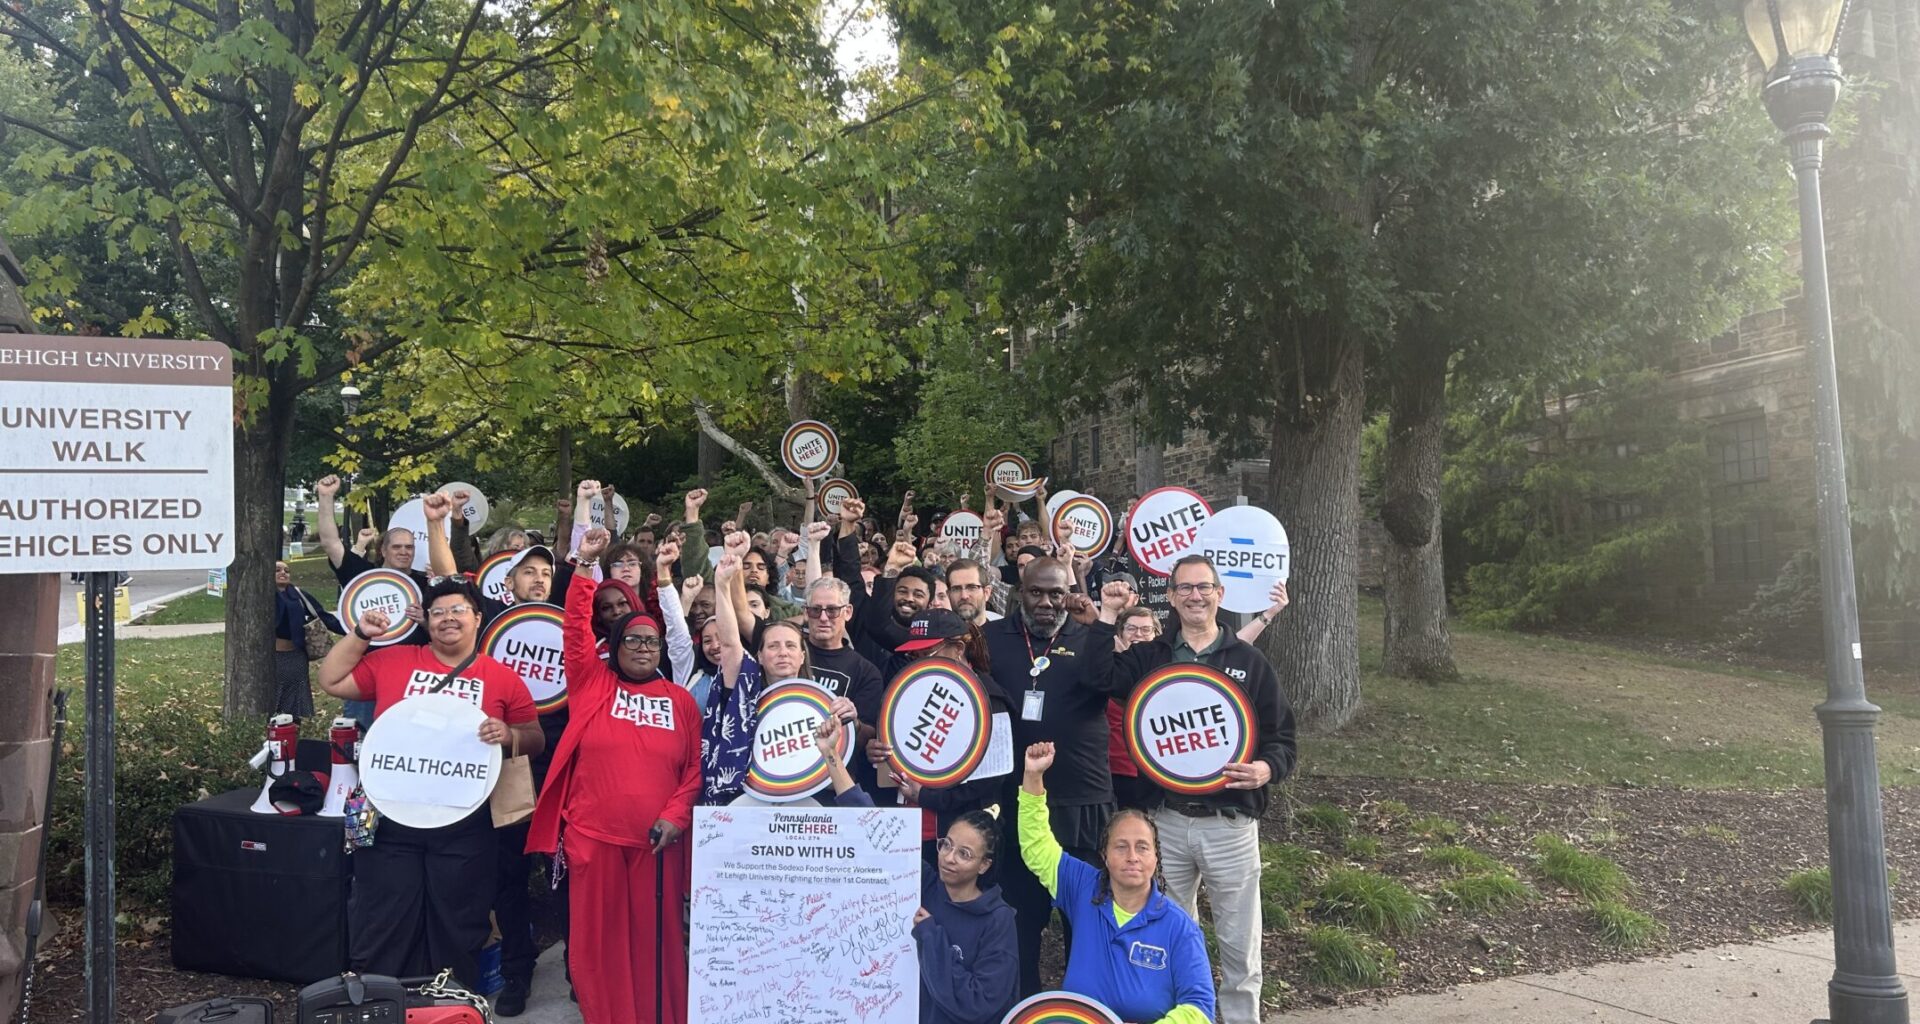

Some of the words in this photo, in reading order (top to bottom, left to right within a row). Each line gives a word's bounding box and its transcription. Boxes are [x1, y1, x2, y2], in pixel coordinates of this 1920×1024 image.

[0, 349, 78, 366] EHIGH
[85, 351, 224, 370] UNIVERSITY
[2, 407, 192, 430] UNIVERSITY
[52, 441, 146, 462] WALK
[795, 437, 821, 455] UNITE
[798, 445, 824, 462] HERE!
[0, 499, 202, 520] AUTHORIZED
[1074, 527, 1096, 539] ERE!
[1133, 502, 1205, 543] UNITE
[0, 534, 132, 557] EHICLES
[142, 533, 224, 554] ONLY
[1141, 523, 1205, 564] HERE
[1204, 549, 1287, 571] RESPECT
[360, 593, 400, 609] UNITE
[502, 657, 565, 685] HERE!
[619, 690, 671, 713] UNITE
[614, 702, 670, 727] HERE!
[904, 682, 949, 751] UNITE
[1149, 703, 1226, 736] UNITE
[760, 716, 817, 746] UNITE
[920, 693, 964, 764] HERE!
[1155, 725, 1229, 757] HERE!
[371, 753, 488, 780] HEALTHCARE
[768, 823, 838, 834] UNITEHERE!
[773, 812, 833, 824] Pennsylvania
[751, 845, 795, 857] STAND
[797, 846, 833, 858] WITH
[837, 846, 856, 859] US
[723, 861, 735, 869] We
[736, 862, 764, 871] Support
[778, 864, 804, 872] Sodexo
[805, 865, 824, 873] Food
[852, 866, 883, 874] Workers
[724, 872, 748, 881] Lehigh
[748, 873, 783, 882] University
[784, 874, 813, 884] Fighting
[813, 875, 823, 883] for
